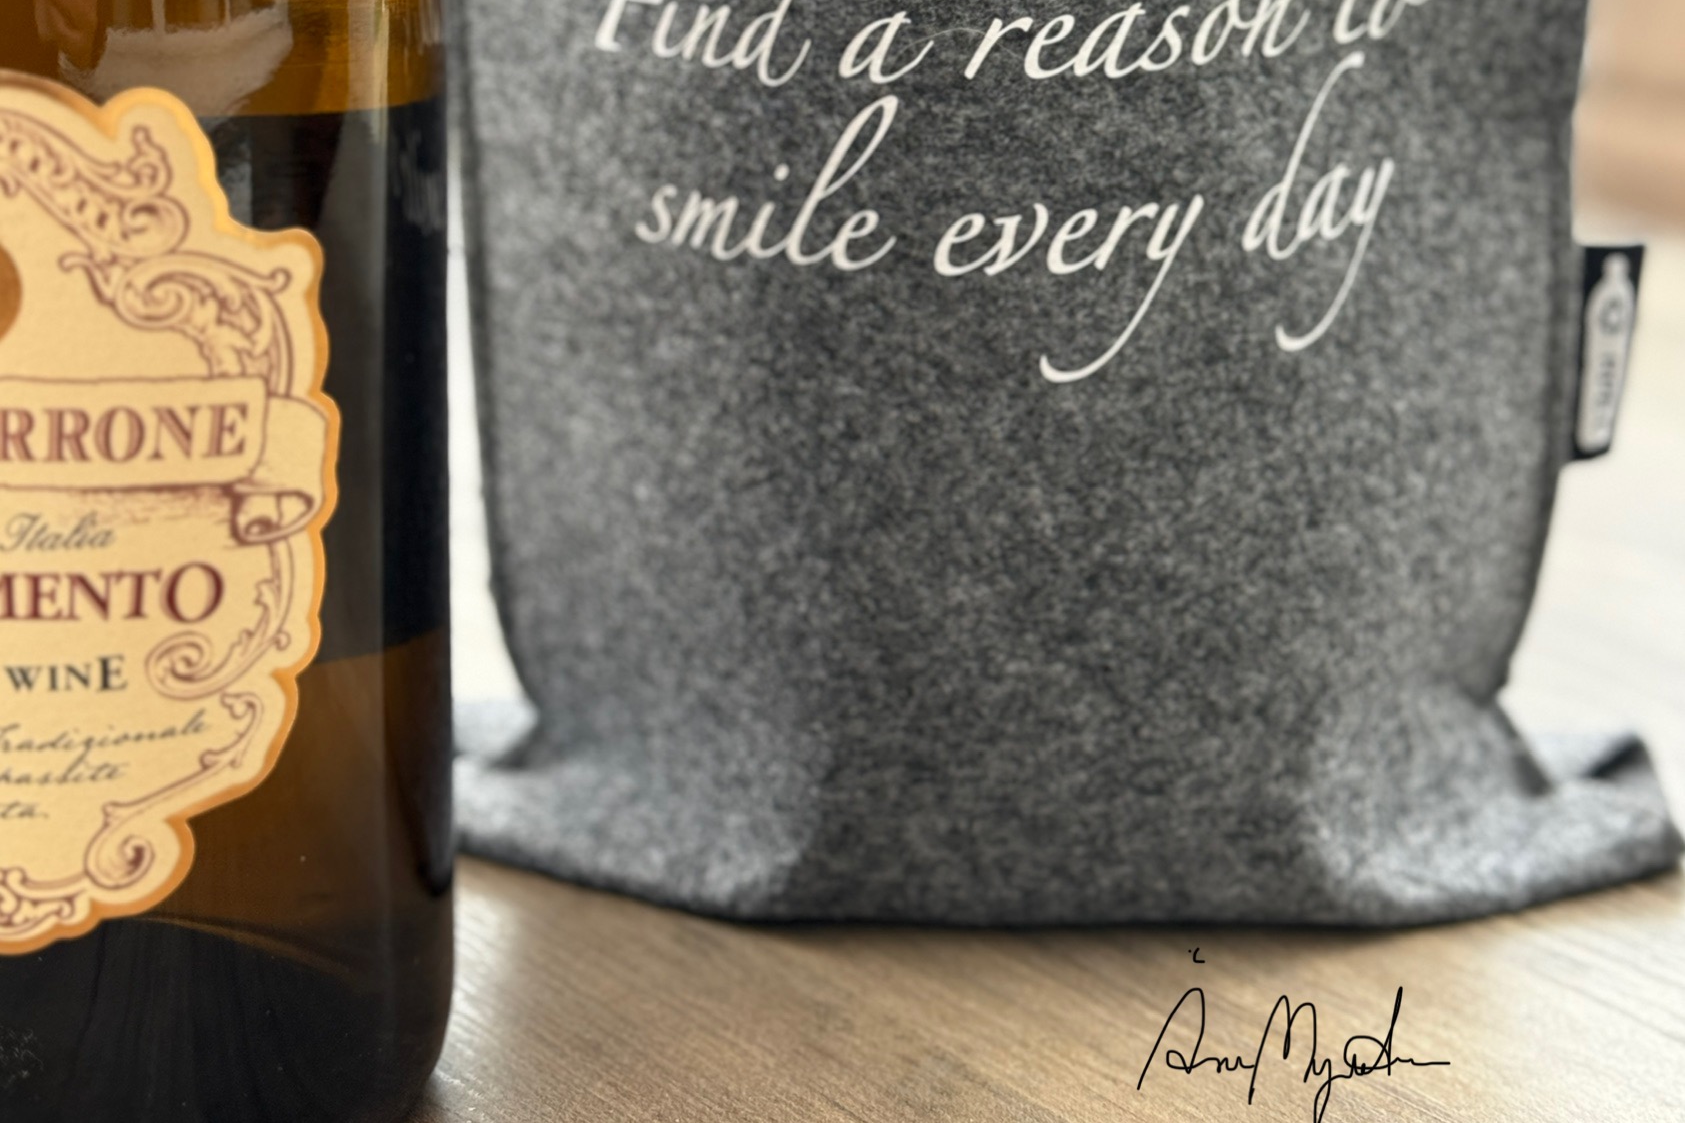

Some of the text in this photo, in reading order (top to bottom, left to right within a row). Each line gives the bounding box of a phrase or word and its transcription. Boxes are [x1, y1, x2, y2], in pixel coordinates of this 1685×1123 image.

[838, 10, 934, 84] a
[635, 51, 1397, 384] smile every day
[0, 402, 250, 464] RRONE
[0, 508, 117, 552] Italia
[5, 654, 128, 693] WINE
